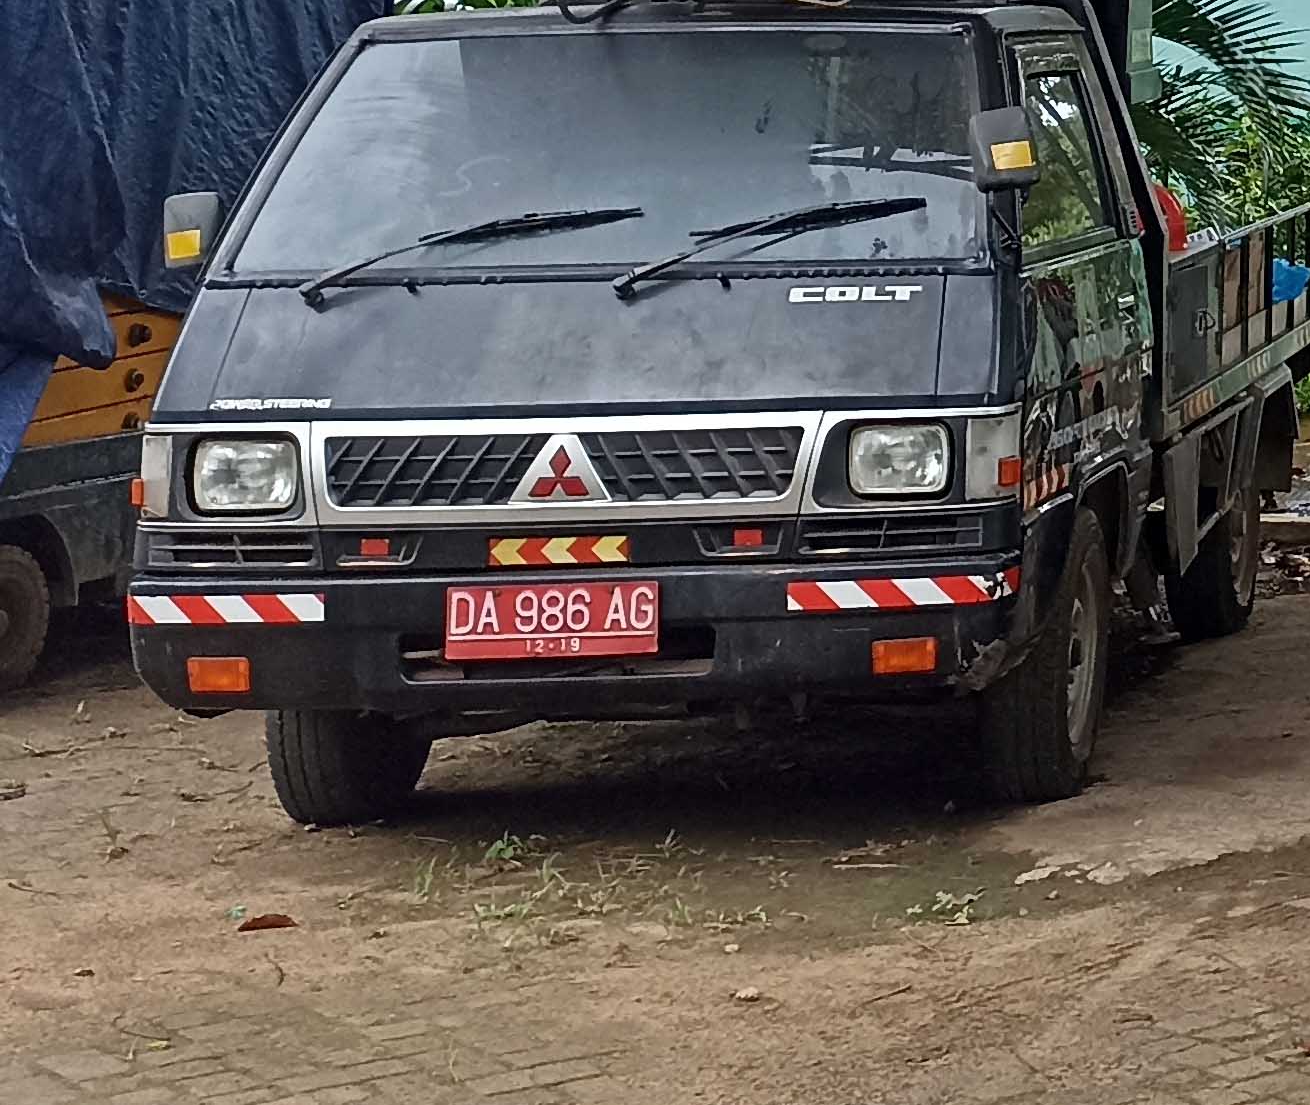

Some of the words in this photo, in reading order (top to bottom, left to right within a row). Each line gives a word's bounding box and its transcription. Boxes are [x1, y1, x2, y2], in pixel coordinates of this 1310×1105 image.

[788, 285, 923, 303] COLT
[450, 590, 500, 636] DA
[514, 589, 592, 633] 986
[603, 586, 655, 630] AG
